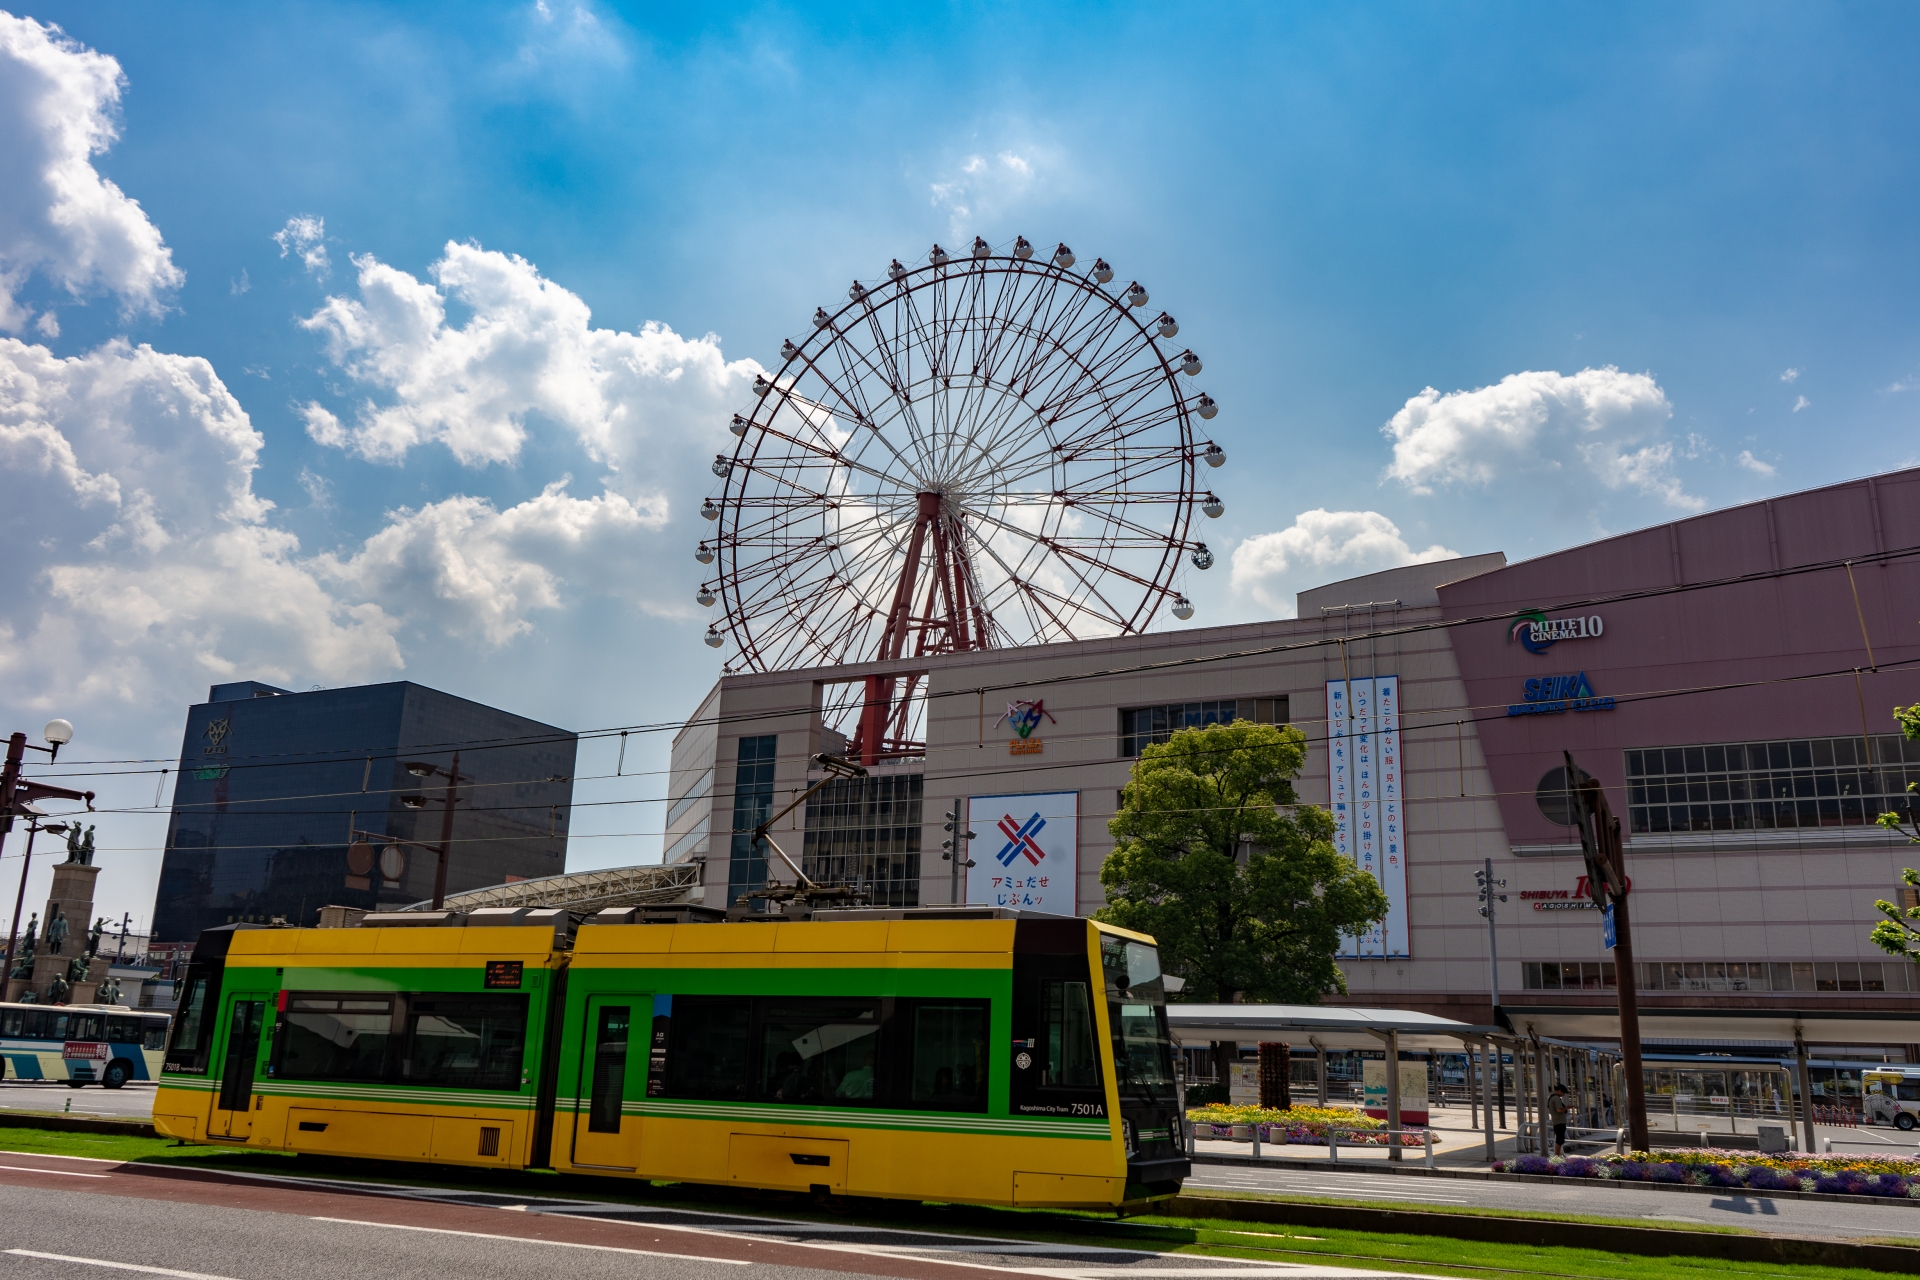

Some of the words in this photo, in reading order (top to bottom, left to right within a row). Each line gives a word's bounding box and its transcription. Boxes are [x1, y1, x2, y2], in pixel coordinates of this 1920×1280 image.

[1530, 618, 1577, 632] MITTE
[1530, 629, 1577, 642] CINEMA
[1576, 615, 1604, 638] 10
[1523, 669, 1595, 702] SEIKA
[1506, 701, 1567, 717] SPORTS
[1572, 697, 1616, 712] CLUB
[1178, 710, 1235, 725] IMAX
[1009, 738, 1043, 749] PLAZA
[1382, 687, 1399, 870] 着たことのない服。見たことのない景色。
[992, 876, 1050, 889] アミュだせ
[997, 893, 1043, 905] じぶんッ
[1519, 890, 1568, 900] SHIBUYA
[164, 1062, 181, 1072] 7501B
[1019, 1104, 1046, 1113] Kagoshima
[1046, 1105, 1056, 1113] City
[1056, 1105, 1069, 1113] Tram
[1070, 1102, 1104, 1116] 7501A
